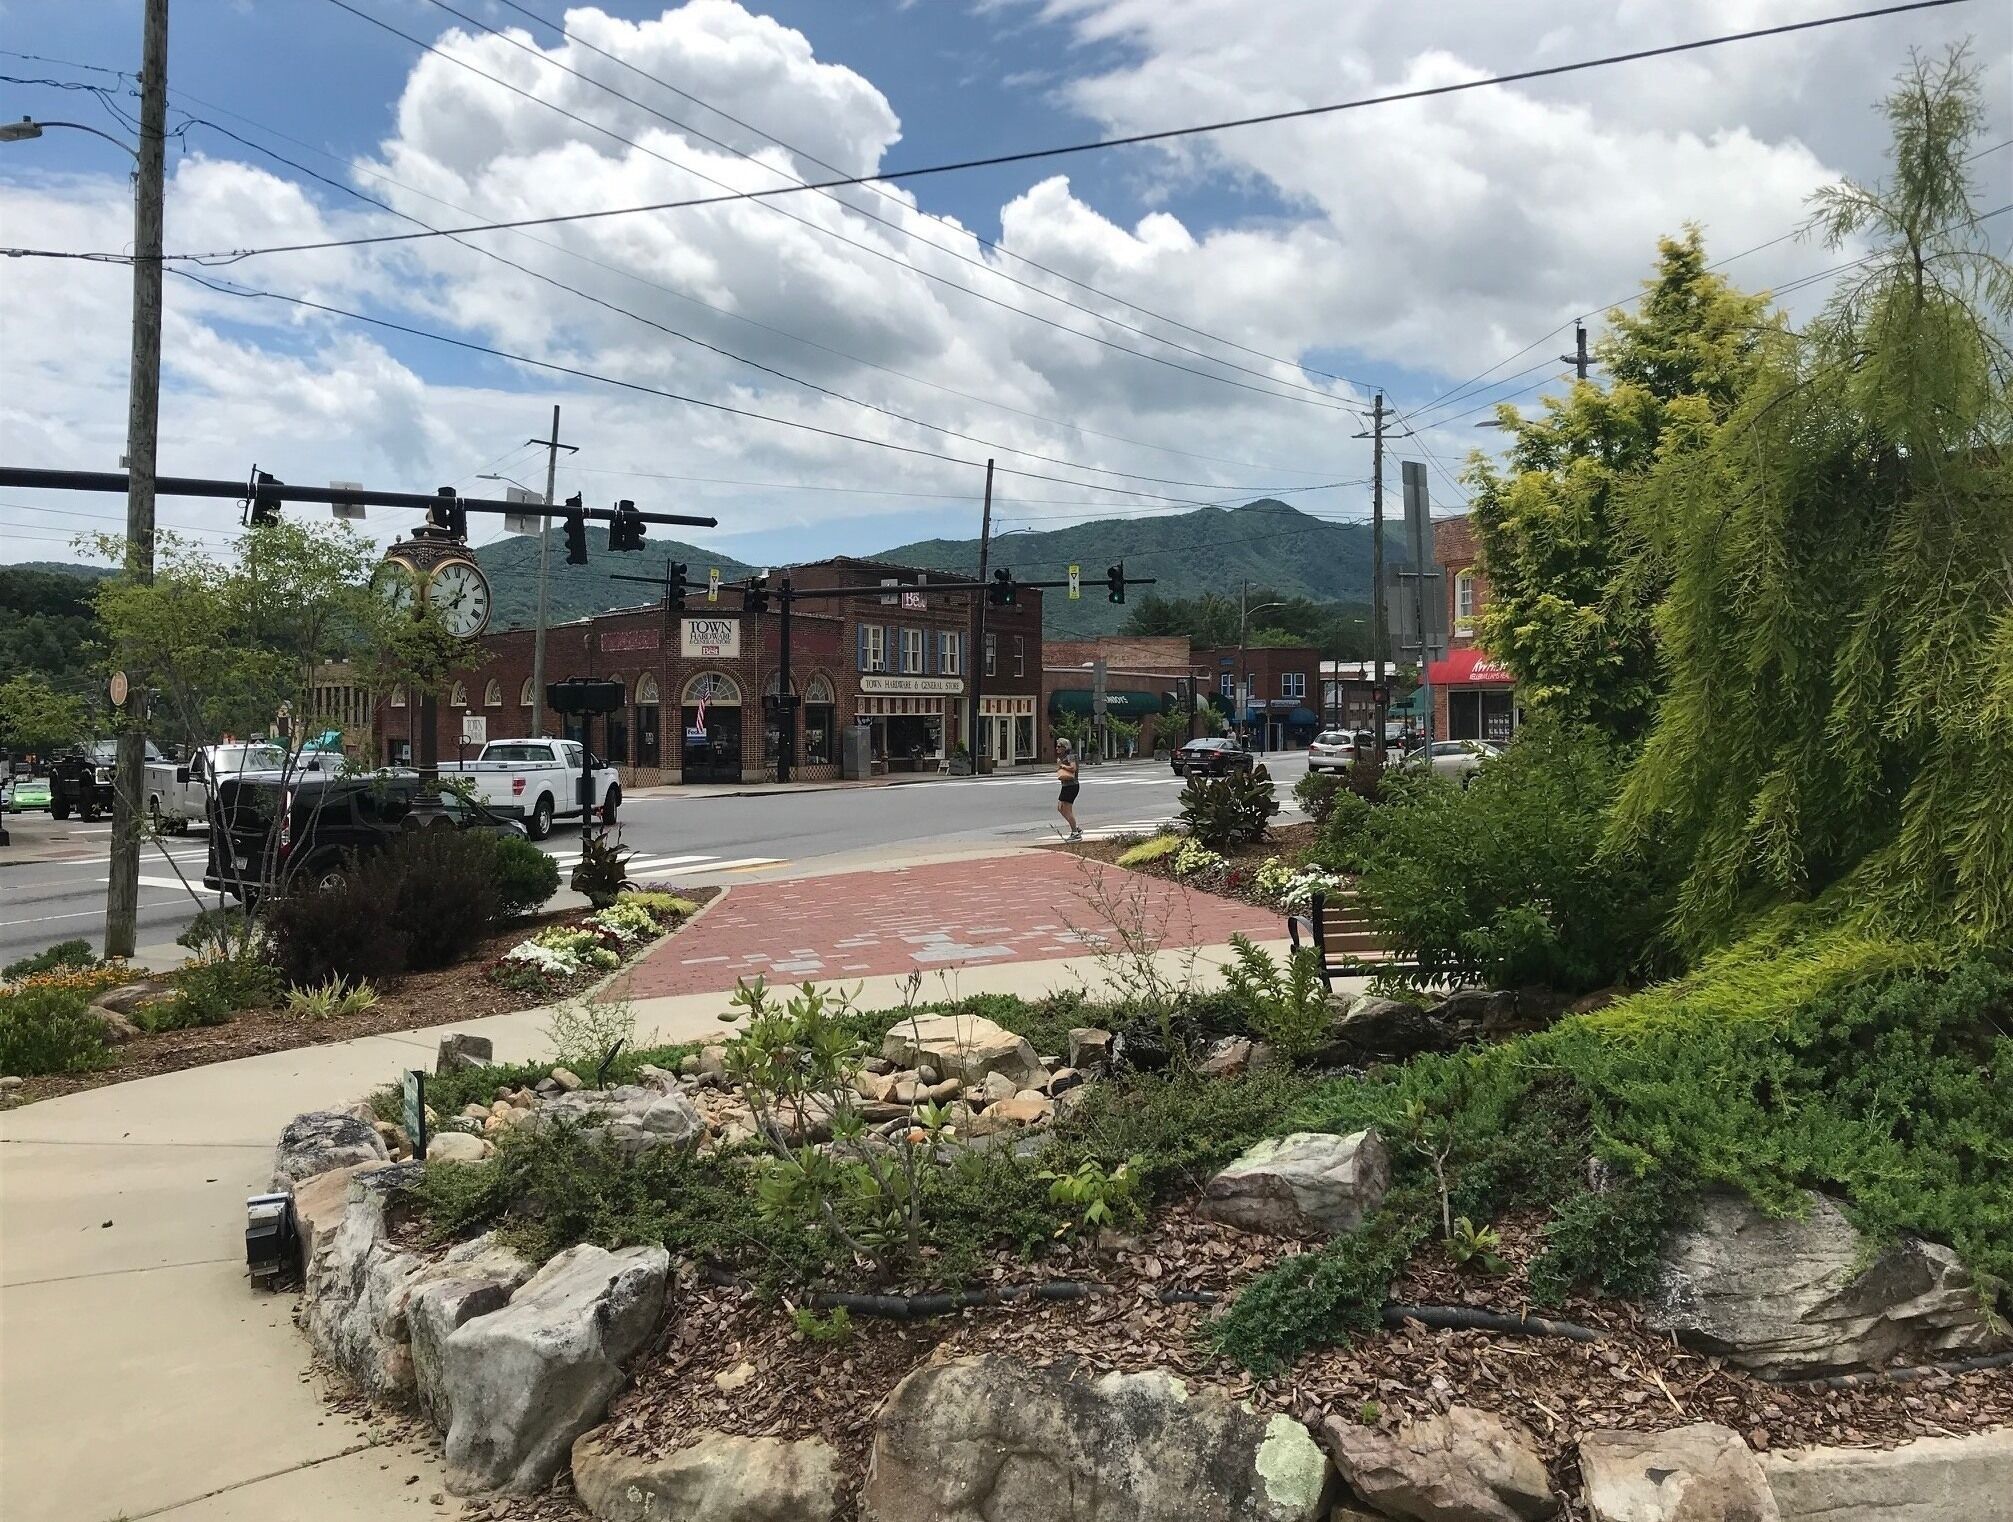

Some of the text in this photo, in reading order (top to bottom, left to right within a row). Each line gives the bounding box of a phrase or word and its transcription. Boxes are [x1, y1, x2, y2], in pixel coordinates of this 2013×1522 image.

[689, 621, 732, 633] TOWN
[116, 679, 124, 698] P
[866, 680, 881, 689] TOWN
[885, 680, 911, 689] HARDWARE
[921, 681, 943, 690] GENERAL
[945, 682, 960, 690] STORE
